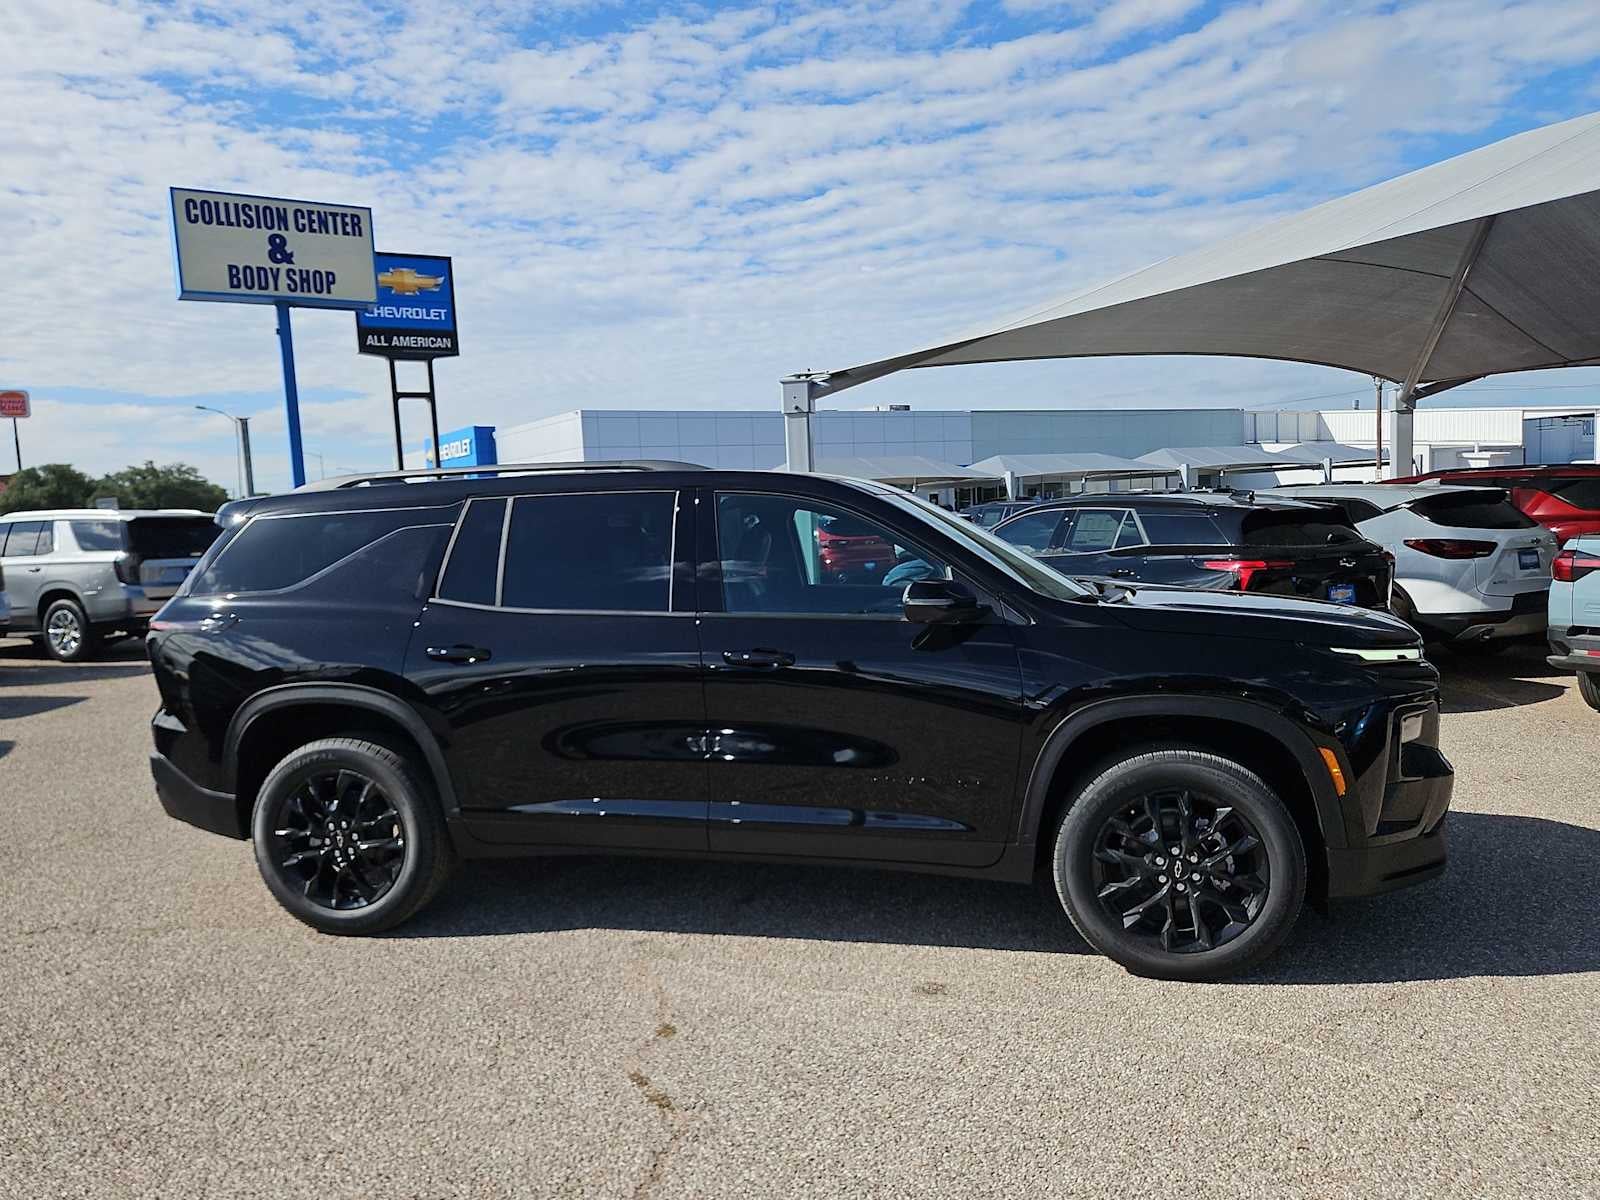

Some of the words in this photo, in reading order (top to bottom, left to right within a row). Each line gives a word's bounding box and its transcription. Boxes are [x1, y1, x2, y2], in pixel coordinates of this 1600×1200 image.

[185, 198, 289, 232] COLLISION
[293, 208, 363, 237] CENTER
[267, 233, 295, 265] &
[227, 264, 280, 291] BODY
[286, 268, 336, 295] SHOP
[366, 335, 389, 346] ALL
[391, 335, 452, 348] AMERICAN
